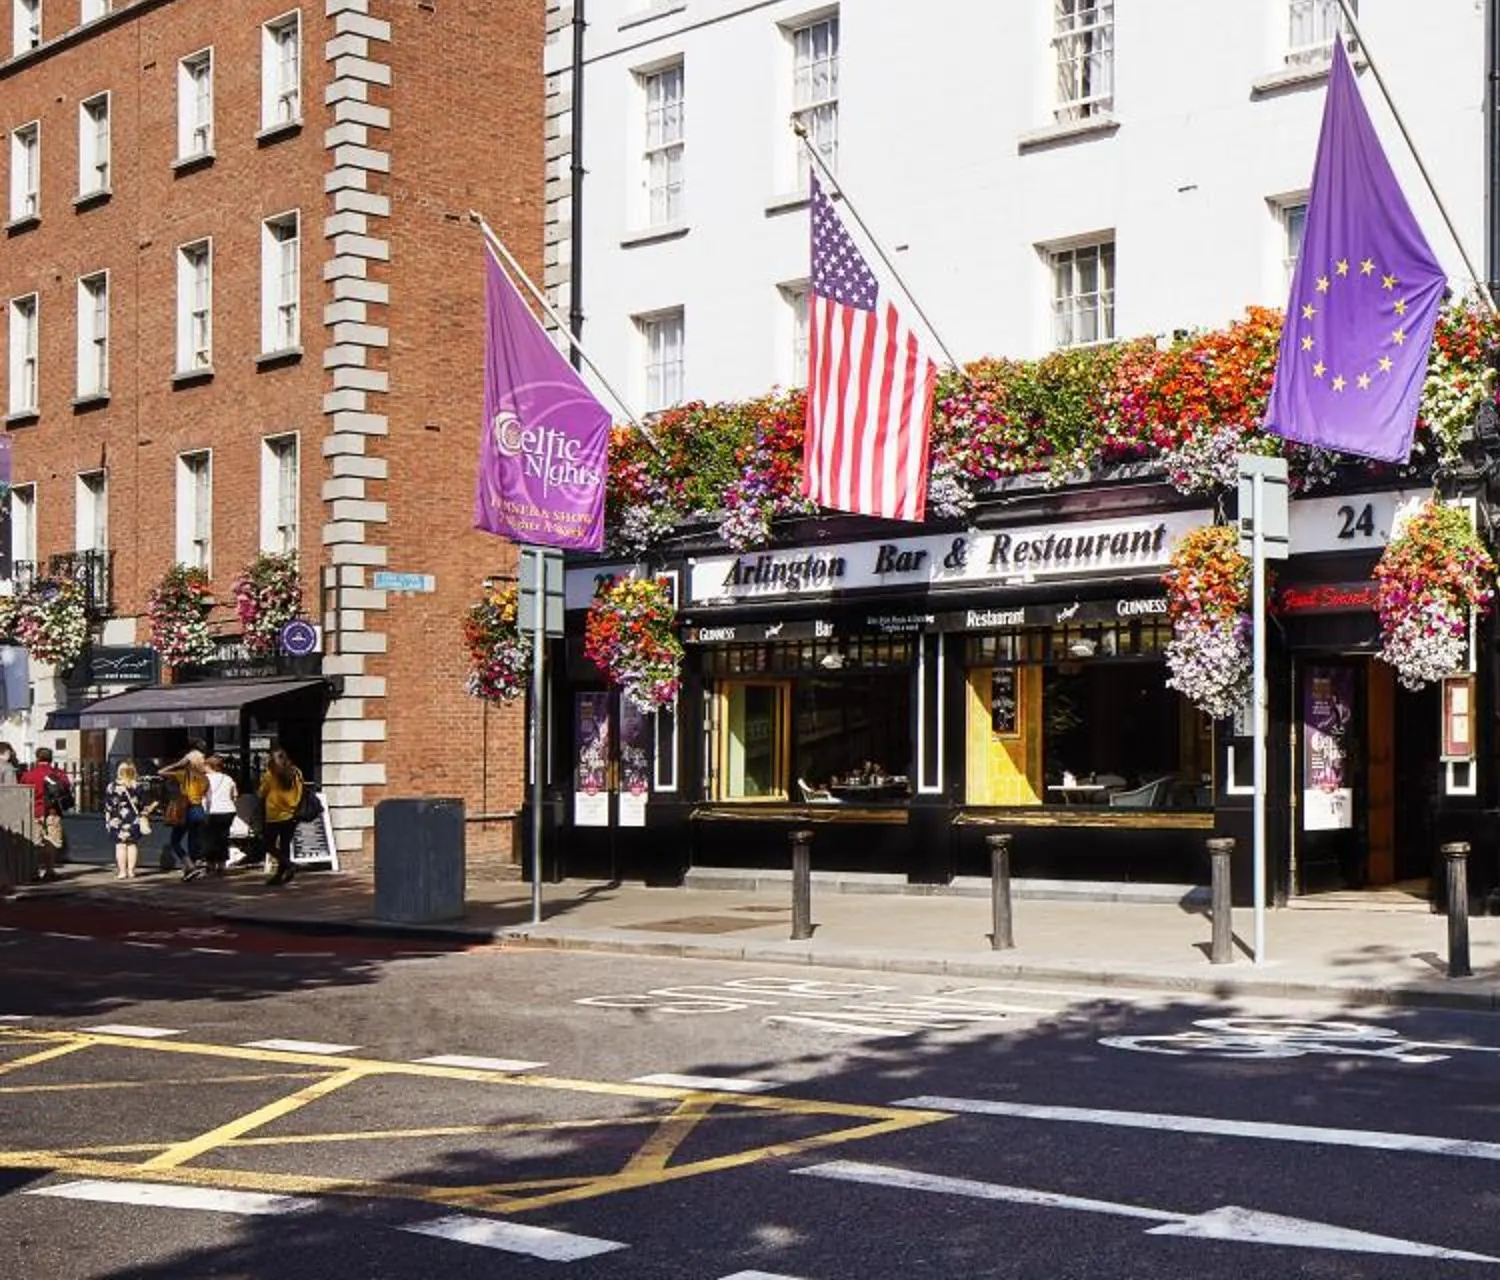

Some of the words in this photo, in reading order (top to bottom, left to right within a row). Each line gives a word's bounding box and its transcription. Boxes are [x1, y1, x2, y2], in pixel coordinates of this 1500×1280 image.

[495, 411, 582, 462] Celtic
[1337, 503, 1375, 539] 24
[722, 555, 846, 590] Arlington
[873, 544, 927, 576] Bar
[944, 537, 968, 568] &
[988, 522, 1168, 566] Restaurant
[966, 607, 1025, 627] Restaurant
[1116, 599, 1168, 616] GUINNESS
[699, 627, 736, 641] GUINNESS
[815, 620, 835, 637] Bar
